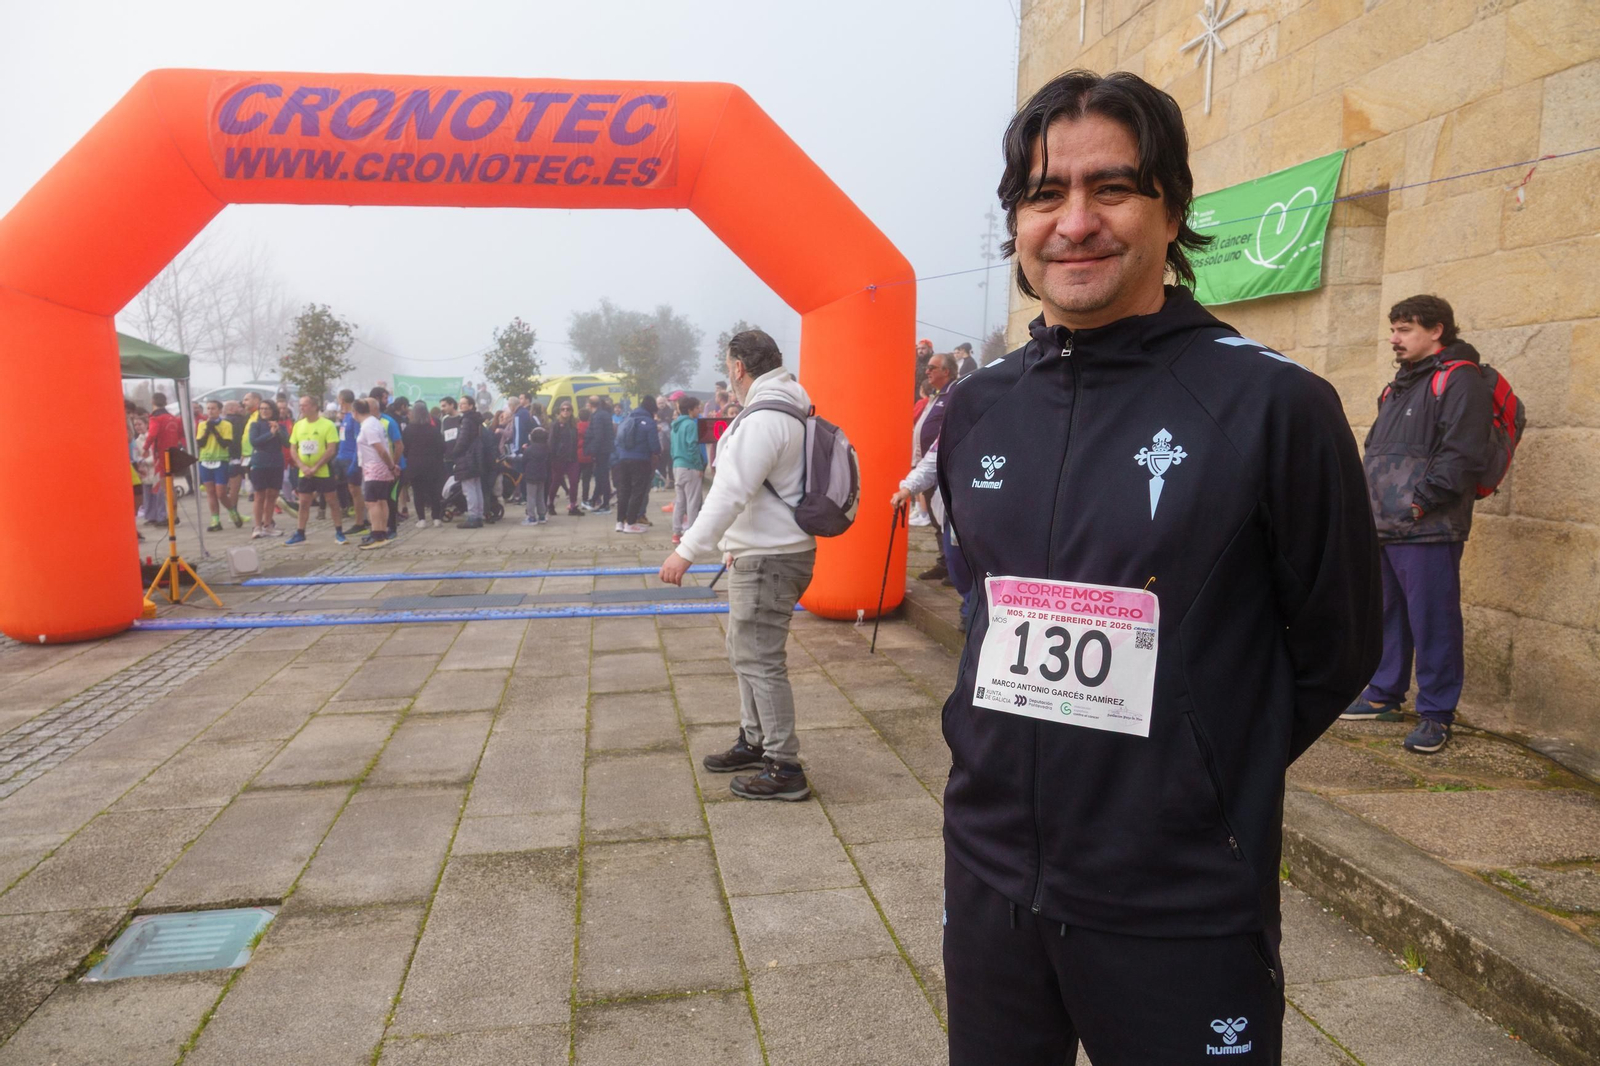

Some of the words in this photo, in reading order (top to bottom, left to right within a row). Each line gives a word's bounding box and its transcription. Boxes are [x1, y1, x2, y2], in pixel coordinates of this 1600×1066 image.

[217, 83, 667, 146] CRONOTEC
[223, 147, 661, 188] WWW.CRONOTEC.ES
[1220, 233, 1253, 249] cáncer
[1204, 252, 1223, 266] solo
[1224, 250, 1241, 262] uno
[971, 478, 1003, 489] hummel
[1017, 582, 1115, 603] CORREMOS
[1055, 600, 1067, 610] O
[1071, 602, 1143, 619] CANCRO
[992, 616, 1008, 624] MOS
[1007, 609, 1025, 618] MOS,
[1027, 611, 1037, 619] 22
[1050, 614, 1093, 626] FEBREIRO
[1095, 619, 1107, 628] DE
[1110, 621, 1132, 630] 2026
[1009, 621, 1112, 687] 130
[986, 688, 1002, 697] XUNTA
[991, 678, 1016, 689] MARCO
[1016, 683, 1050, 695] ANTONIO
[1051, 688, 1084, 701] GARCÉS
[1086, 694, 1124, 707] RAMÍREZ
[992, 696, 1011, 704] GALICIA
[1206, 1040, 1252, 1055] hummel
